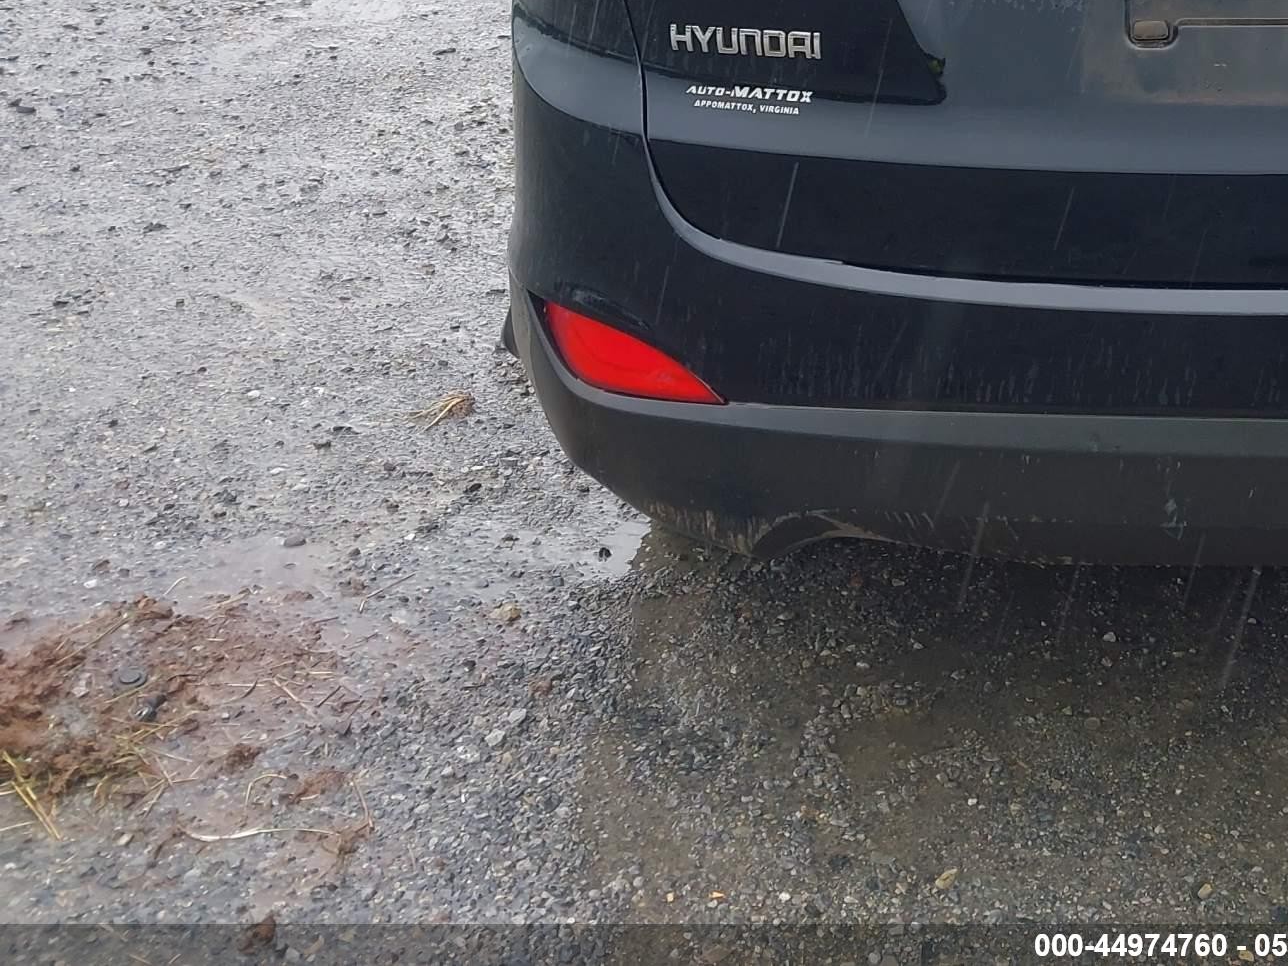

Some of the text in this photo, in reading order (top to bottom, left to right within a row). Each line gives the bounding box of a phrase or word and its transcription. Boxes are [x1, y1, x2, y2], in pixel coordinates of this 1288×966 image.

[669, 23, 822, 60] HYUNDAI
[686, 85, 813, 104] AUTO-MATTOX
[693, 99, 800, 115] APPOMATTOX, VIRGINIA
